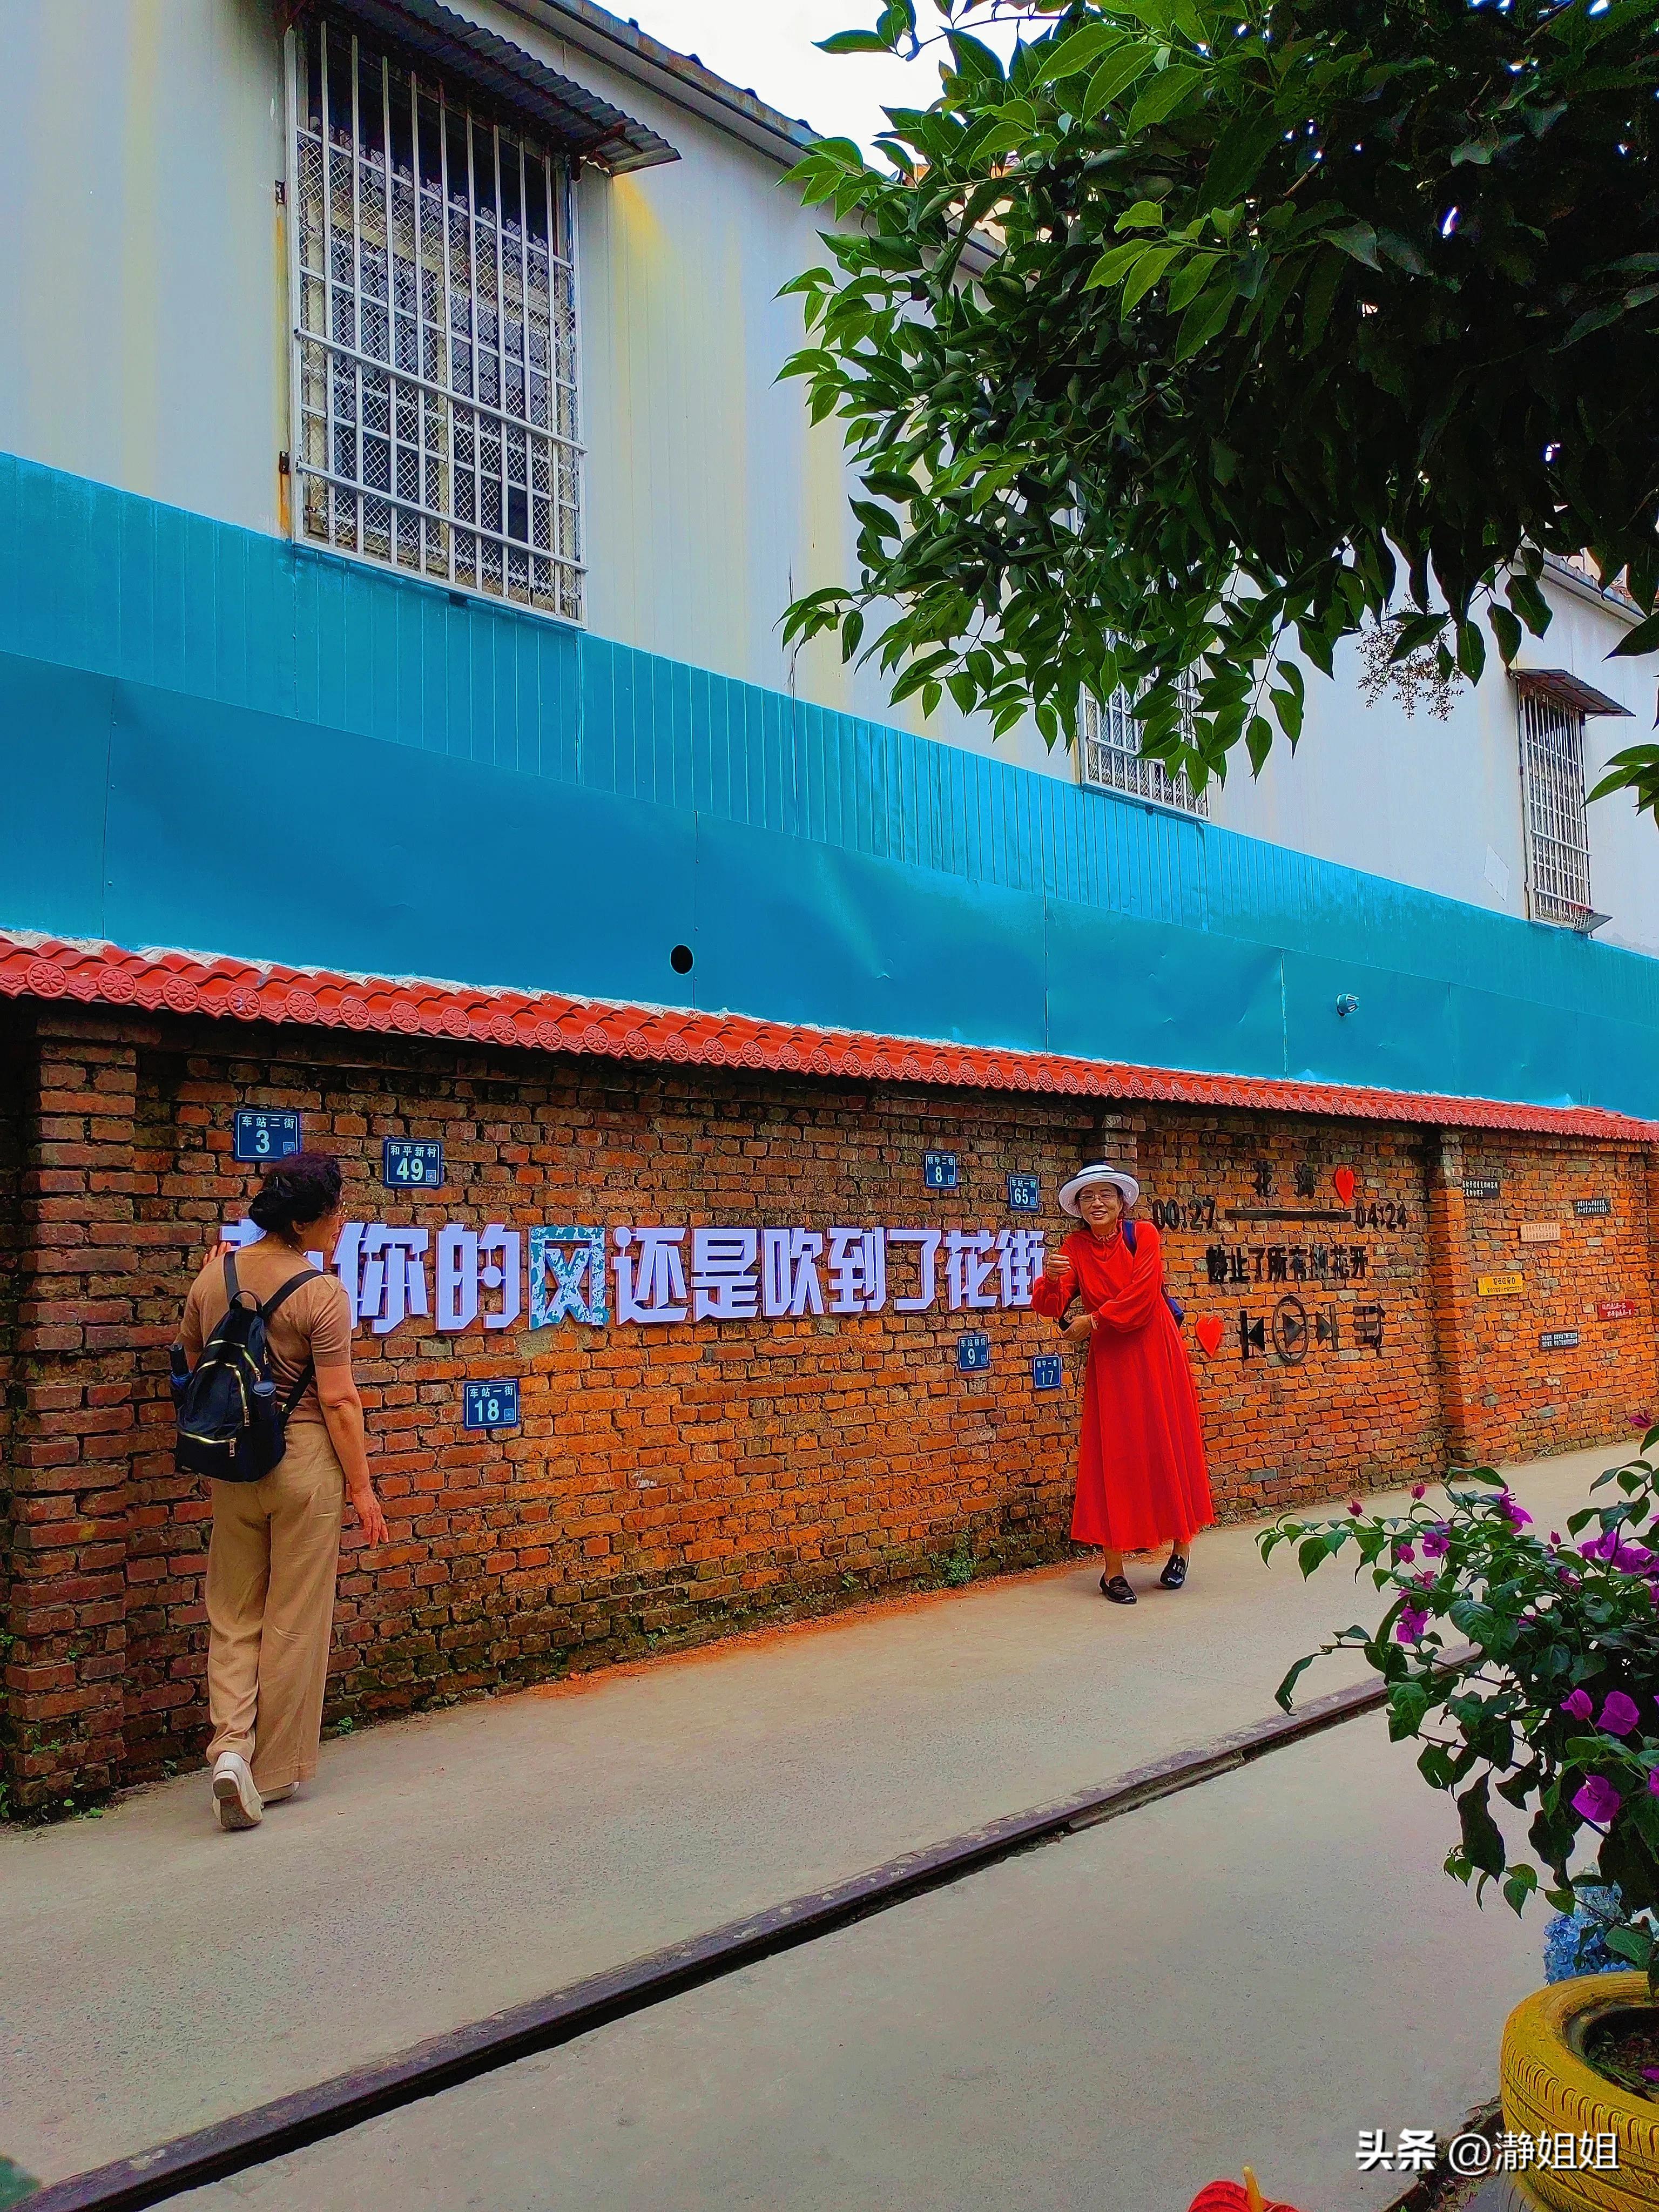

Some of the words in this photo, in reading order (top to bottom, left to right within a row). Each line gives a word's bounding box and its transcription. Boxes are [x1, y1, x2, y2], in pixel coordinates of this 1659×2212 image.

[241, 1116, 294, 1129] 车站二街
[255, 1130, 270, 1154] 3
[390, 1145, 436, 1157] 和平新村
[397, 1158, 423, 1181] 49
[935, 1166, 942, 1183] 8
[1011, 1179, 1035, 1188] 车站一街
[1015, 1188, 1028, 1204] 65
[1152, 1199, 1216, 1231] 00:27
[1355, 1199, 1407, 1230] 04:24
[220, 1218, 1045, 1334] 你的风还是吹到了花街
[968, 1348, 975, 1365] 9
[1041, 1371, 1054, 1384] 17
[470, 1386, 513, 1398] 车站一街
[475, 1399, 499, 1421] 18
